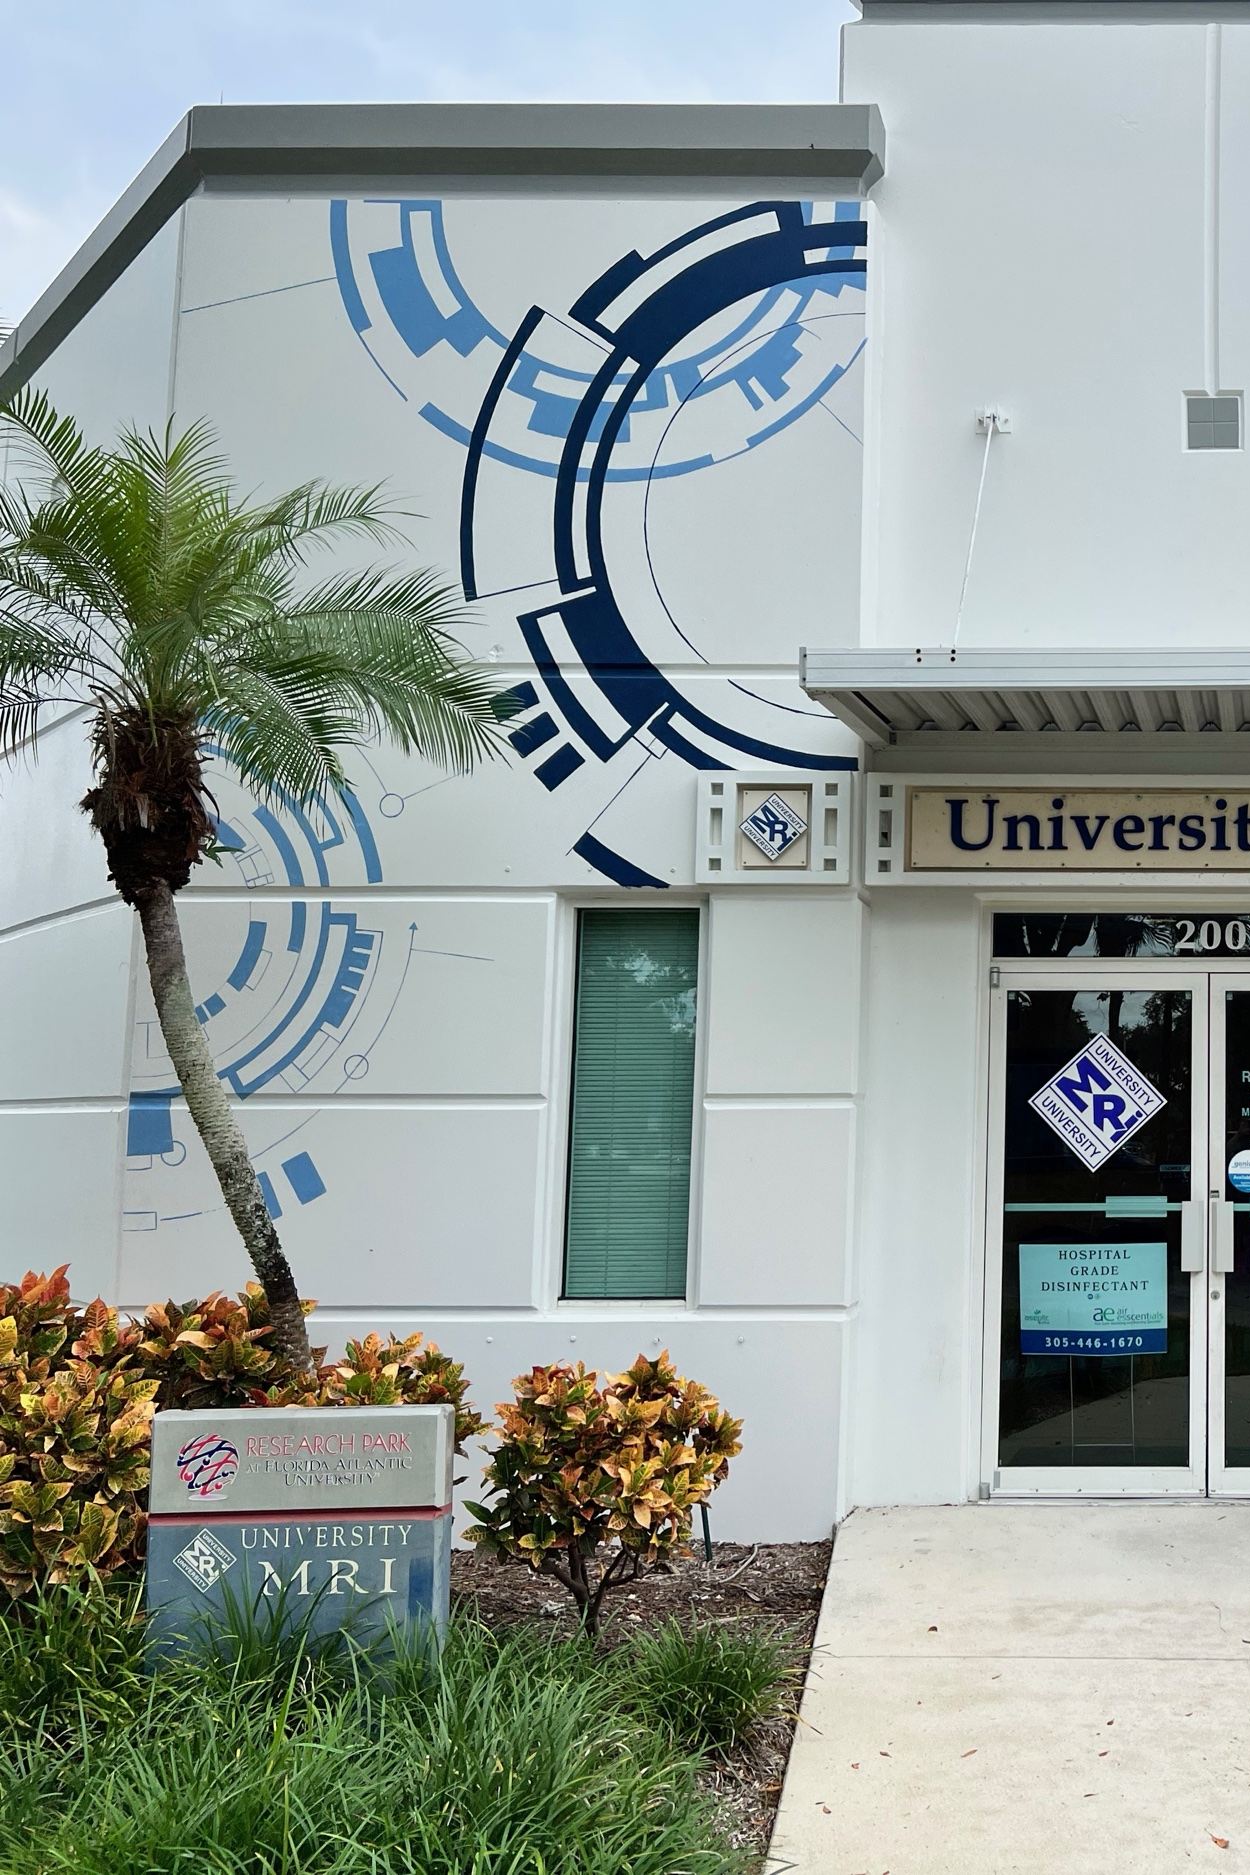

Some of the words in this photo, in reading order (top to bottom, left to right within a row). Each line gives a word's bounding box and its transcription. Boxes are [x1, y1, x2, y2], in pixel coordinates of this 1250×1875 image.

[771, 797, 804, 830] UNIVERSITY
[743, 825, 776, 857] UNIVERSITY
[1174, 919, 1247, 950] 200
[1094, 1044, 1155, 1106] UNIVERSITY
[1041, 1095, 1102, 1158] UNIVERSITY
[1058, 1249, 1131, 1260] HOSPITAL
[1070, 1265, 1119, 1276] GRADE
[1041, 1280, 1149, 1292] DISINFECTANT
[1093, 1307, 1115, 1321] ae
[1116, 1311, 1164, 1321] esscentials
[1117, 1307, 1128, 1315] air
[1045, 1336, 1143, 1348] 305-446-1670
[246, 1434, 355, 1457] RESEARCH
[362, 1432, 412, 1454] PARK
[246, 1462, 262, 1473] AT
[265, 1458, 330, 1473] FLORIDA
[335, 1457, 412, 1471] ATLANTIC
[284, 1472, 377, 1487] UNIVERSITY
[202, 1533, 232, 1562] UNIVERSITY
[240, 1525, 412, 1549] UNIVERSITY
[176, 1558, 207, 1588] UNIVERSITY
[258, 1558, 398, 1596] MRI
